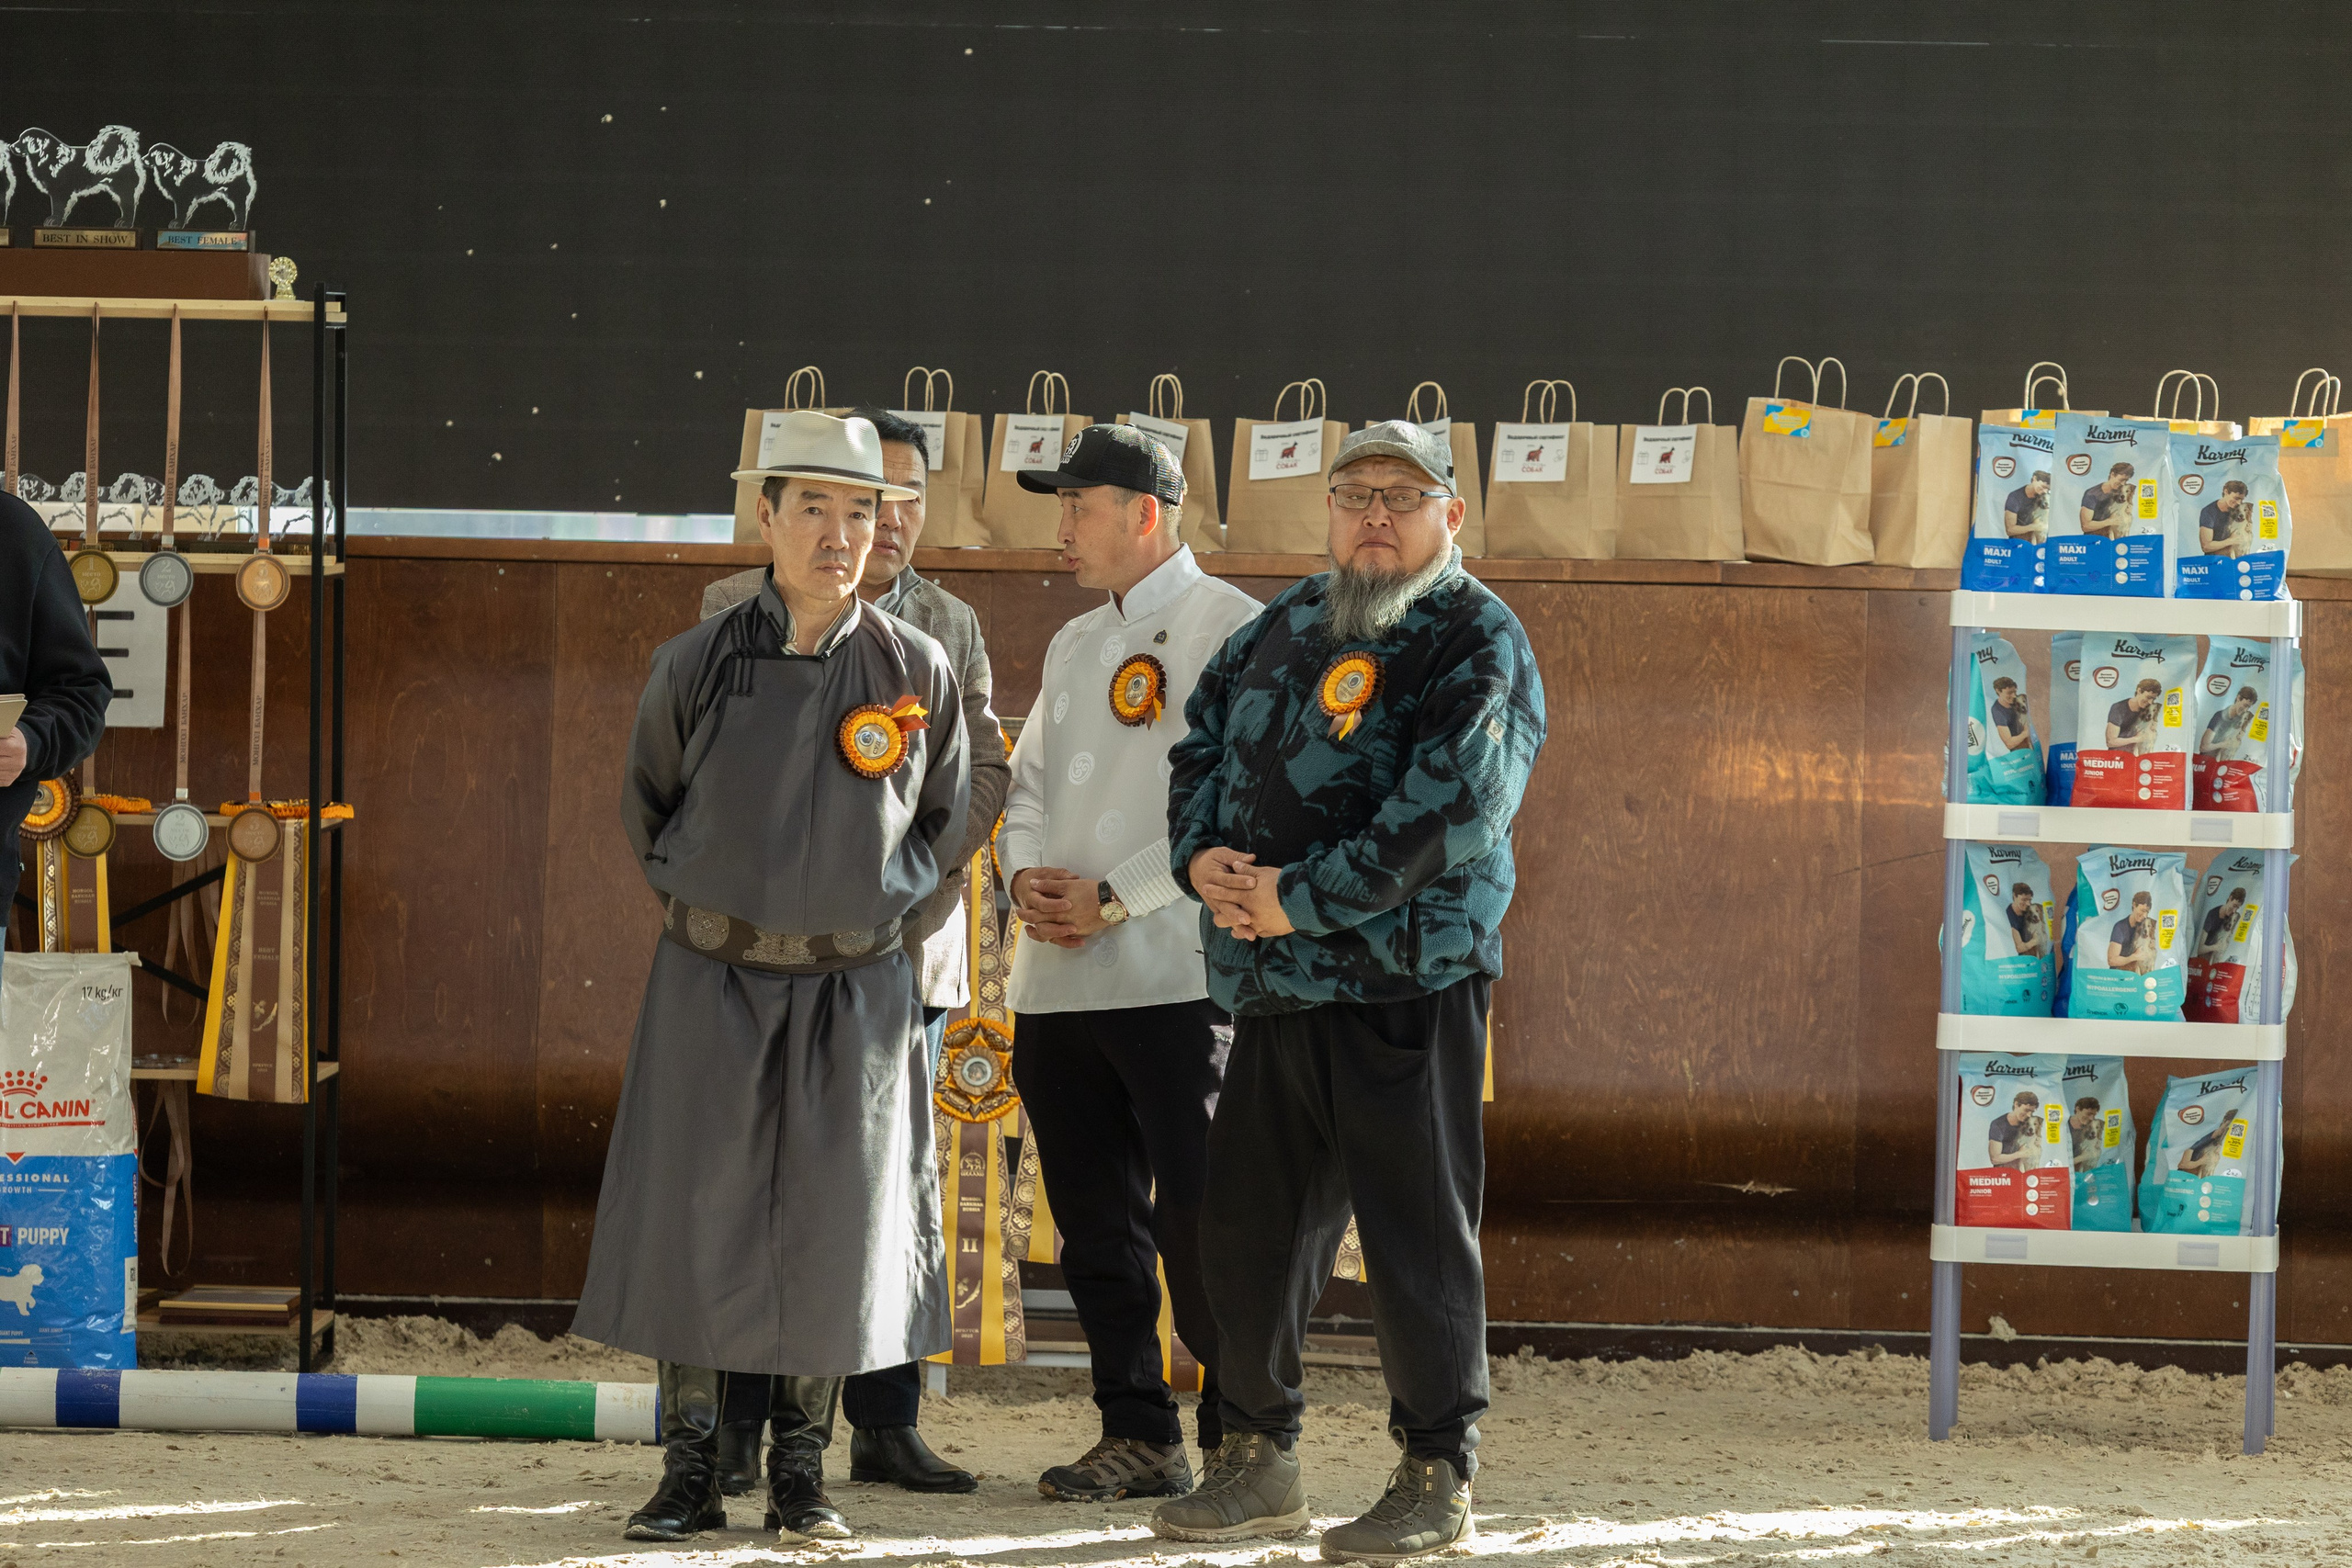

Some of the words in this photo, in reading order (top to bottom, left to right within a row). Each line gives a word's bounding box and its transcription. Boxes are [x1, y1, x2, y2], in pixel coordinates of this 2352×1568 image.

[42, 233, 71, 243] BEST
[76, 234, 88, 243] IN
[94, 234, 128, 245] SHOW
[168, 235, 191, 244] BEST
[198, 236, 237, 245] FEMALE
[2086, 424, 2138, 447] Karmy
[2197, 445, 2248, 466] Karmy
[1984, 547, 2011, 557] MAXI
[2059, 546, 2086, 554] MAXI
[2182, 566, 2209, 575] MAXI
[2114, 639, 2164, 664] Karmy
[254, 695, 263, 728] БАНХАР
[2061, 754, 2077, 764] MAX
[2084, 760, 2124, 770] MEDIUM
[2109, 854, 2157, 876] Karmy
[82, 987, 93, 998] 17
[1985, 1060, 2037, 1079] Karmy
[2064, 1064, 2098, 1083] rmy
[19, 1099, 90, 1119] CANIN
[1969, 1178, 2011, 1186] MEDIUM
[0, 1186, 32, 1194] ROWTH
[17, 1227, 70, 1246] PUPPY
[962, 1237, 978, 1253] II
